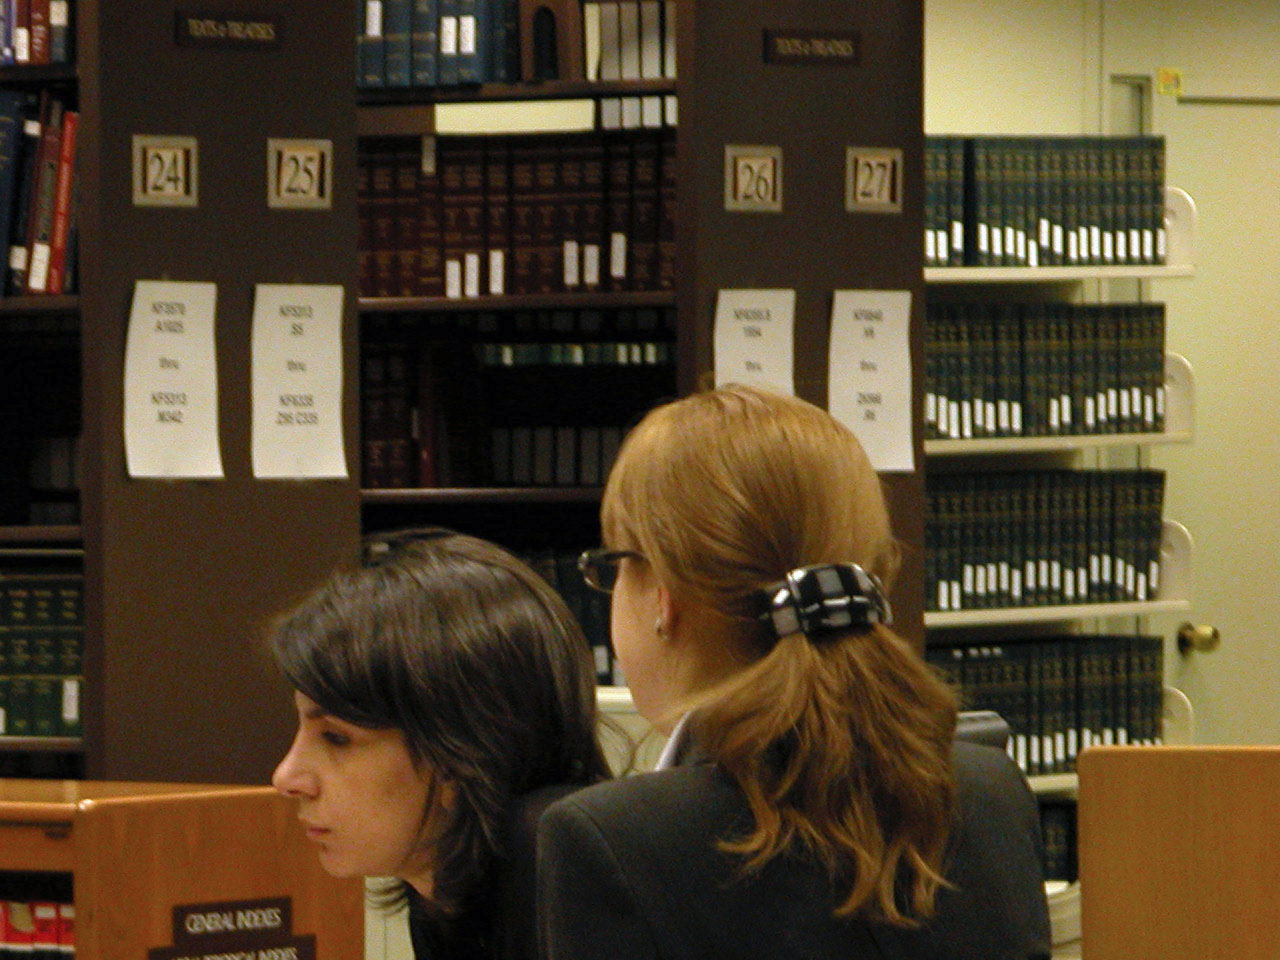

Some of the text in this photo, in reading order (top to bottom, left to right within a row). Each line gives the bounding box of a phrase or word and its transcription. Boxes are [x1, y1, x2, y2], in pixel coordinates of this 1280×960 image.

[151, 152, 181, 192] 24
[285, 154, 315, 194] 25
[741, 163, 769, 200] 26
[860, 160, 888, 197] 27
